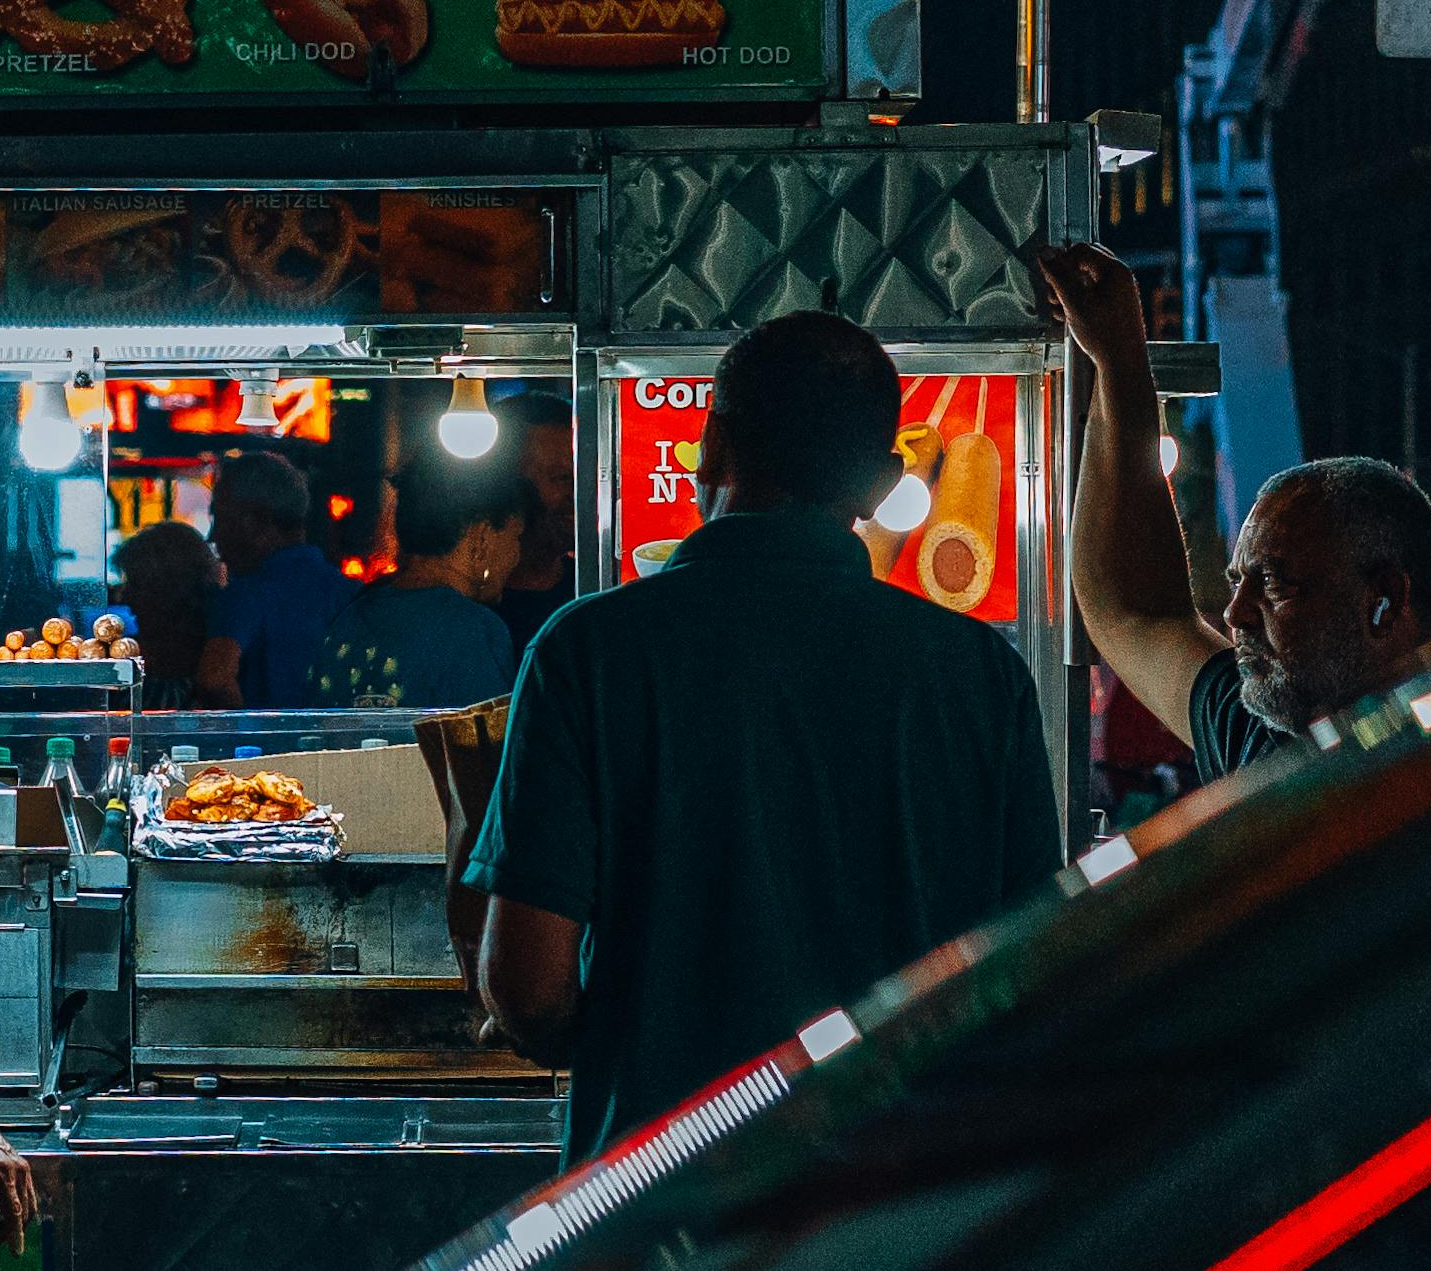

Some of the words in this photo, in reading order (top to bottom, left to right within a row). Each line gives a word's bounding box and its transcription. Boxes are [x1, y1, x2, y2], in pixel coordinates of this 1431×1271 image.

[304, 41, 356, 61] DOD
[682, 46, 732, 67] HOT
[739, 46, 792, 66] DOD
[12, 199, 85, 213] ITALIAN
[91, 196, 187, 212] SAUSAGE
[242, 194, 332, 211] PRETZEL
[635, 377, 714, 409] Cor
[654, 440, 674, 472] I
